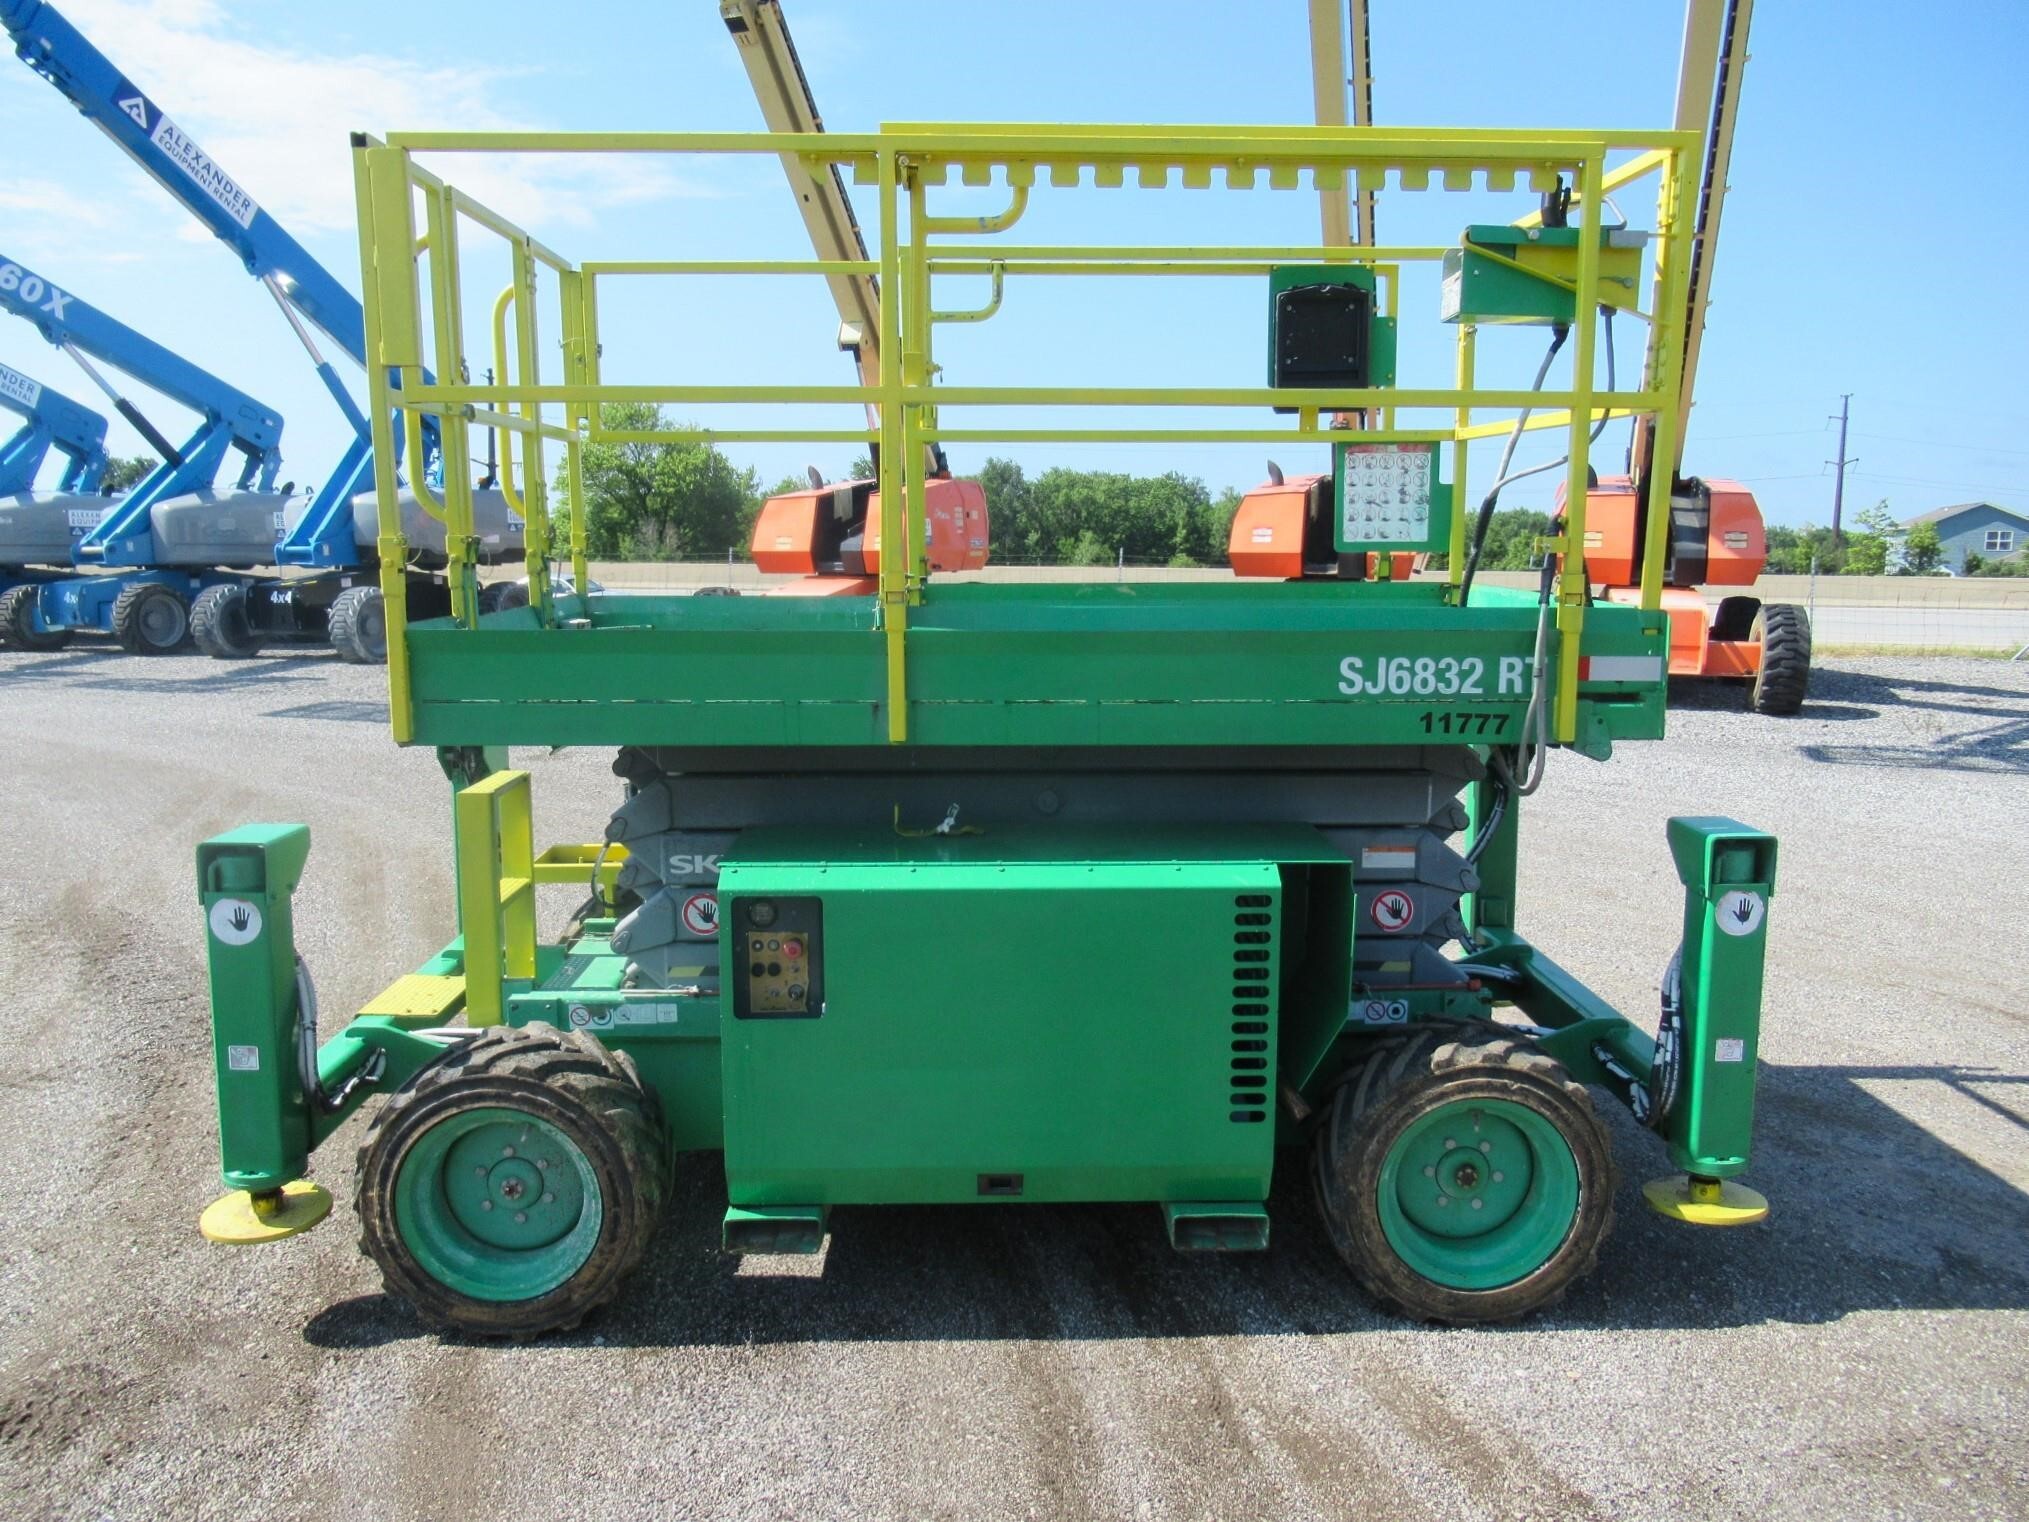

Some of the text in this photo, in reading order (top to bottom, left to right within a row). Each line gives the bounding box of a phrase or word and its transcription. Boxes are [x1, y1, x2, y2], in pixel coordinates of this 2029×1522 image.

[158, 135, 245, 220] EQUIPMENT RENTAL
[163, 126, 251, 211] ALEXANDER
[0, 263, 74, 321] 60X
[270, 591, 292, 604] 4x4
[1338, 656, 1484, 695] SJ6832
[1419, 711, 1510, 734] 11777
